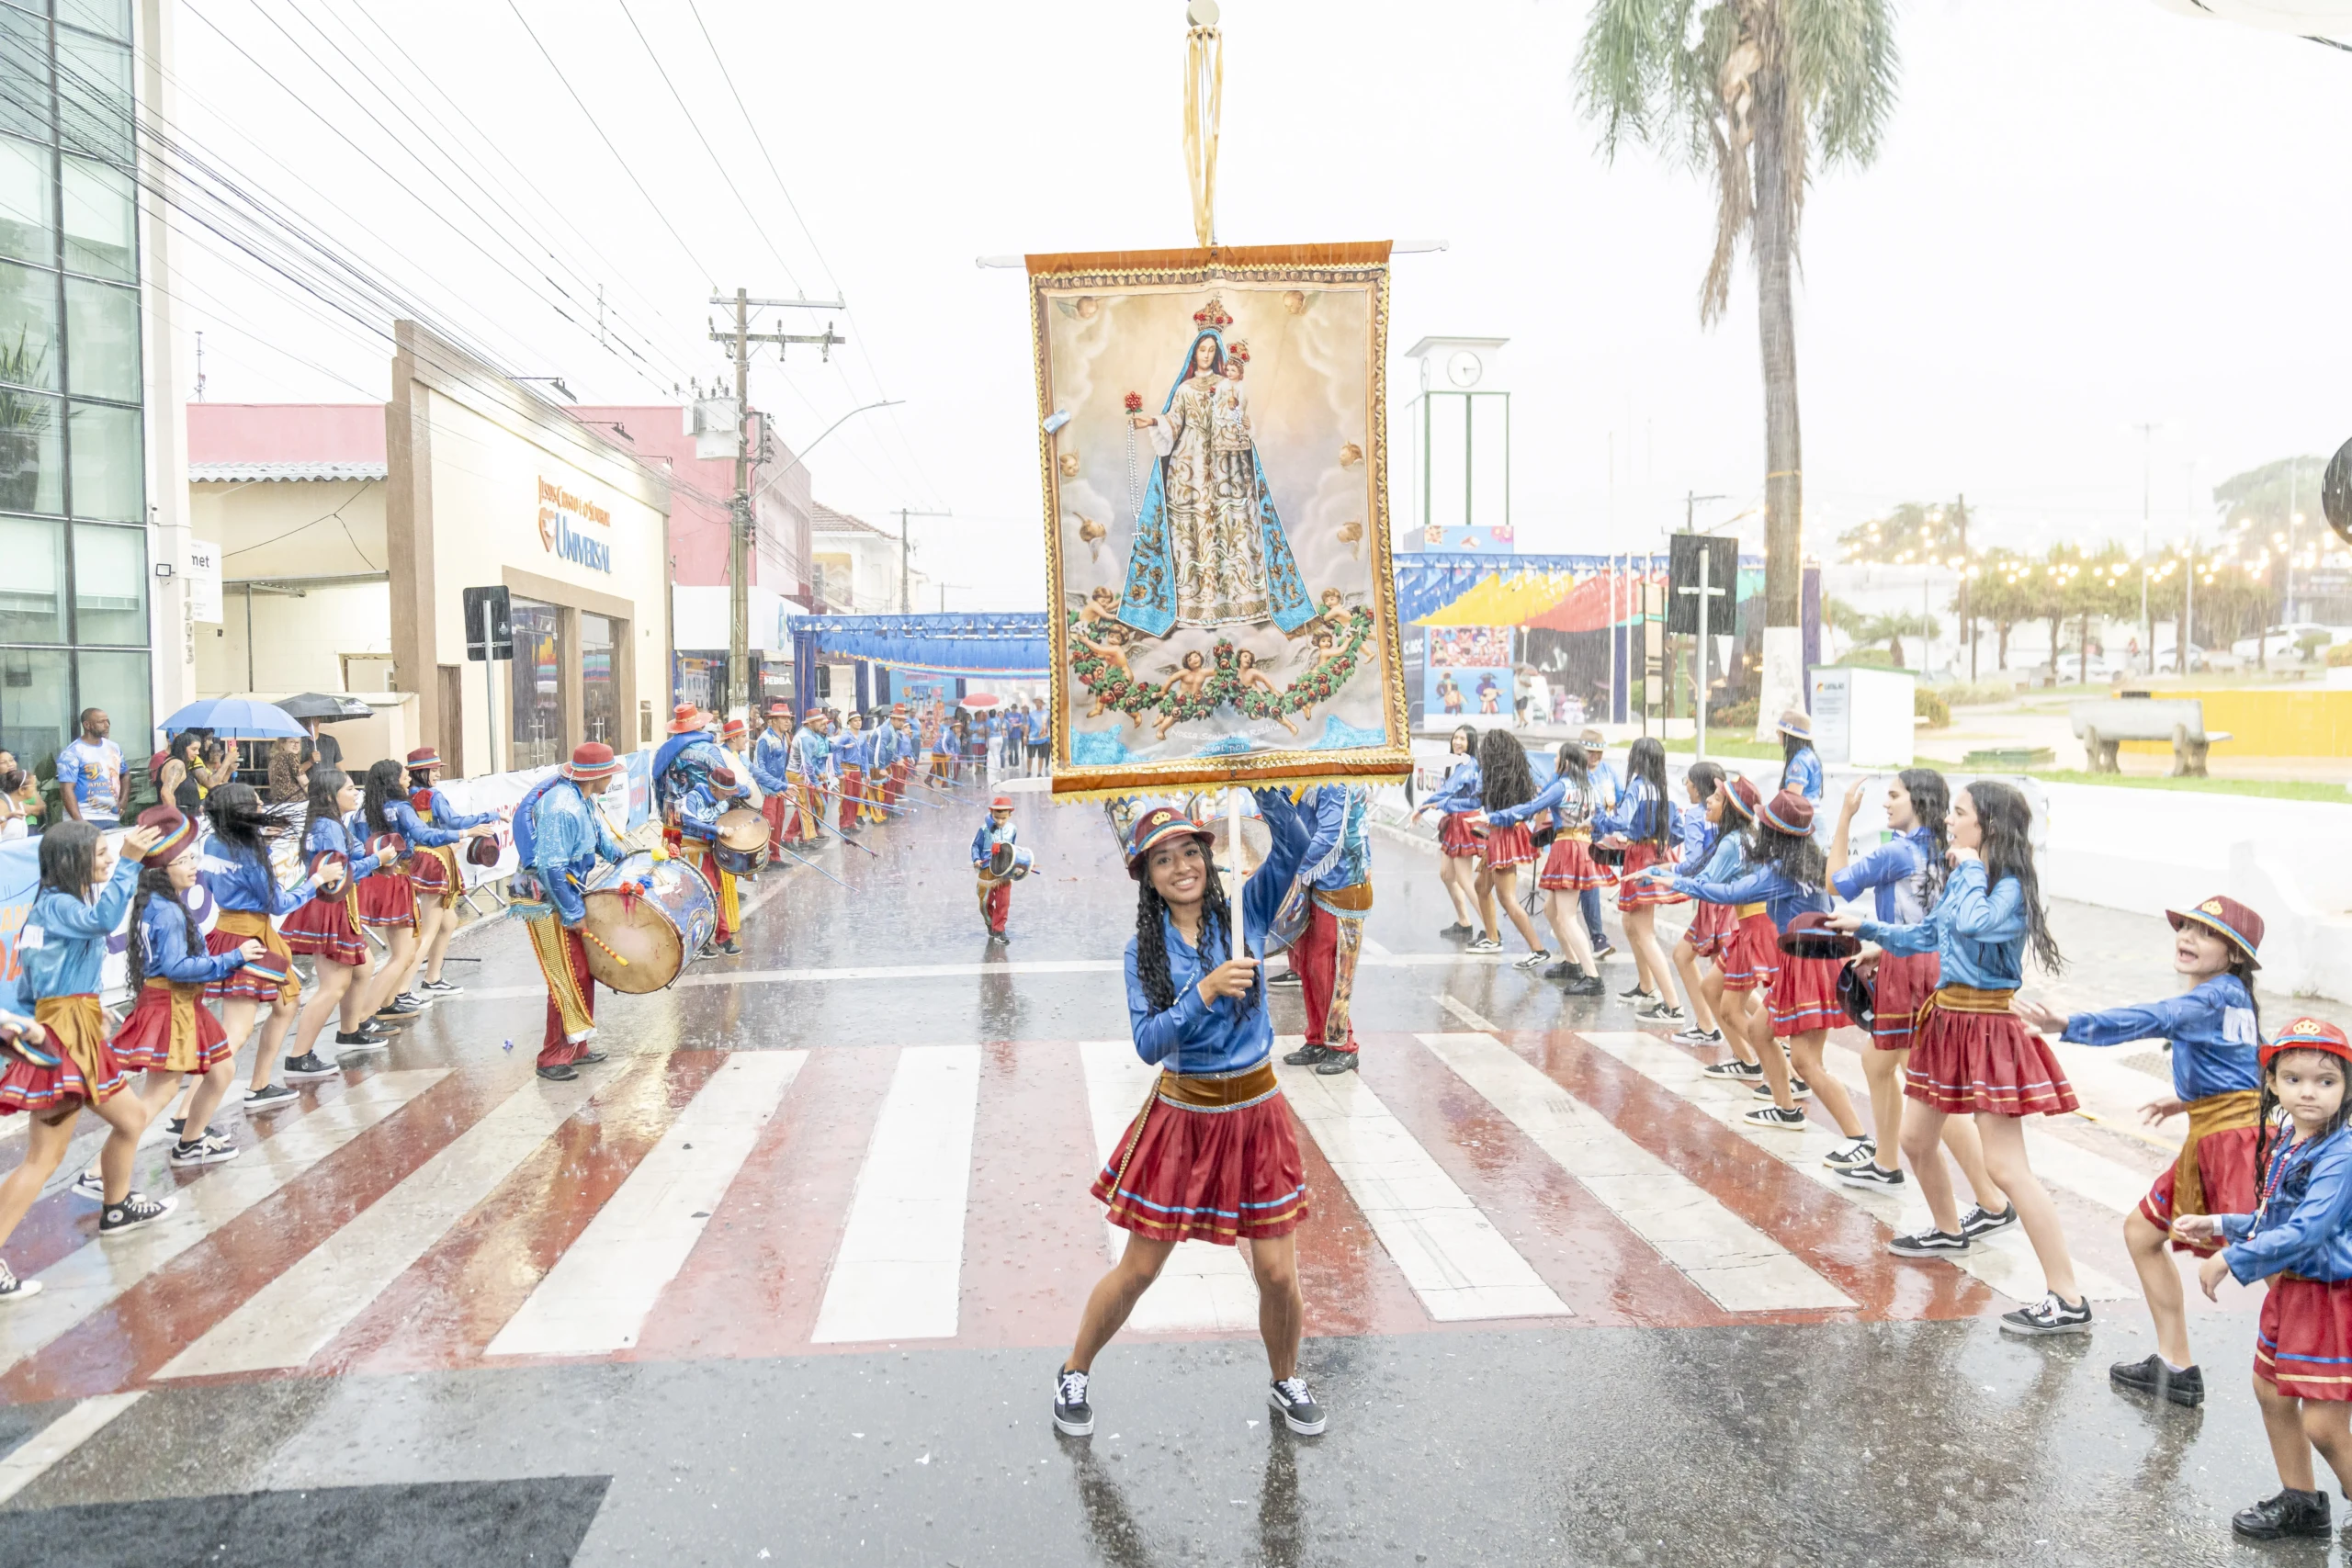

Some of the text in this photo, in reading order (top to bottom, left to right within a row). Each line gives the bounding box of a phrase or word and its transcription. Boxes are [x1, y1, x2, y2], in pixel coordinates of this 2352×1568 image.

[555, 513, 611, 574] UNIVERSAL
[1170, 728, 1198, 739] Nossa
[1200, 730, 1237, 740] Senhora
[1249, 722, 1282, 737] Rosário
